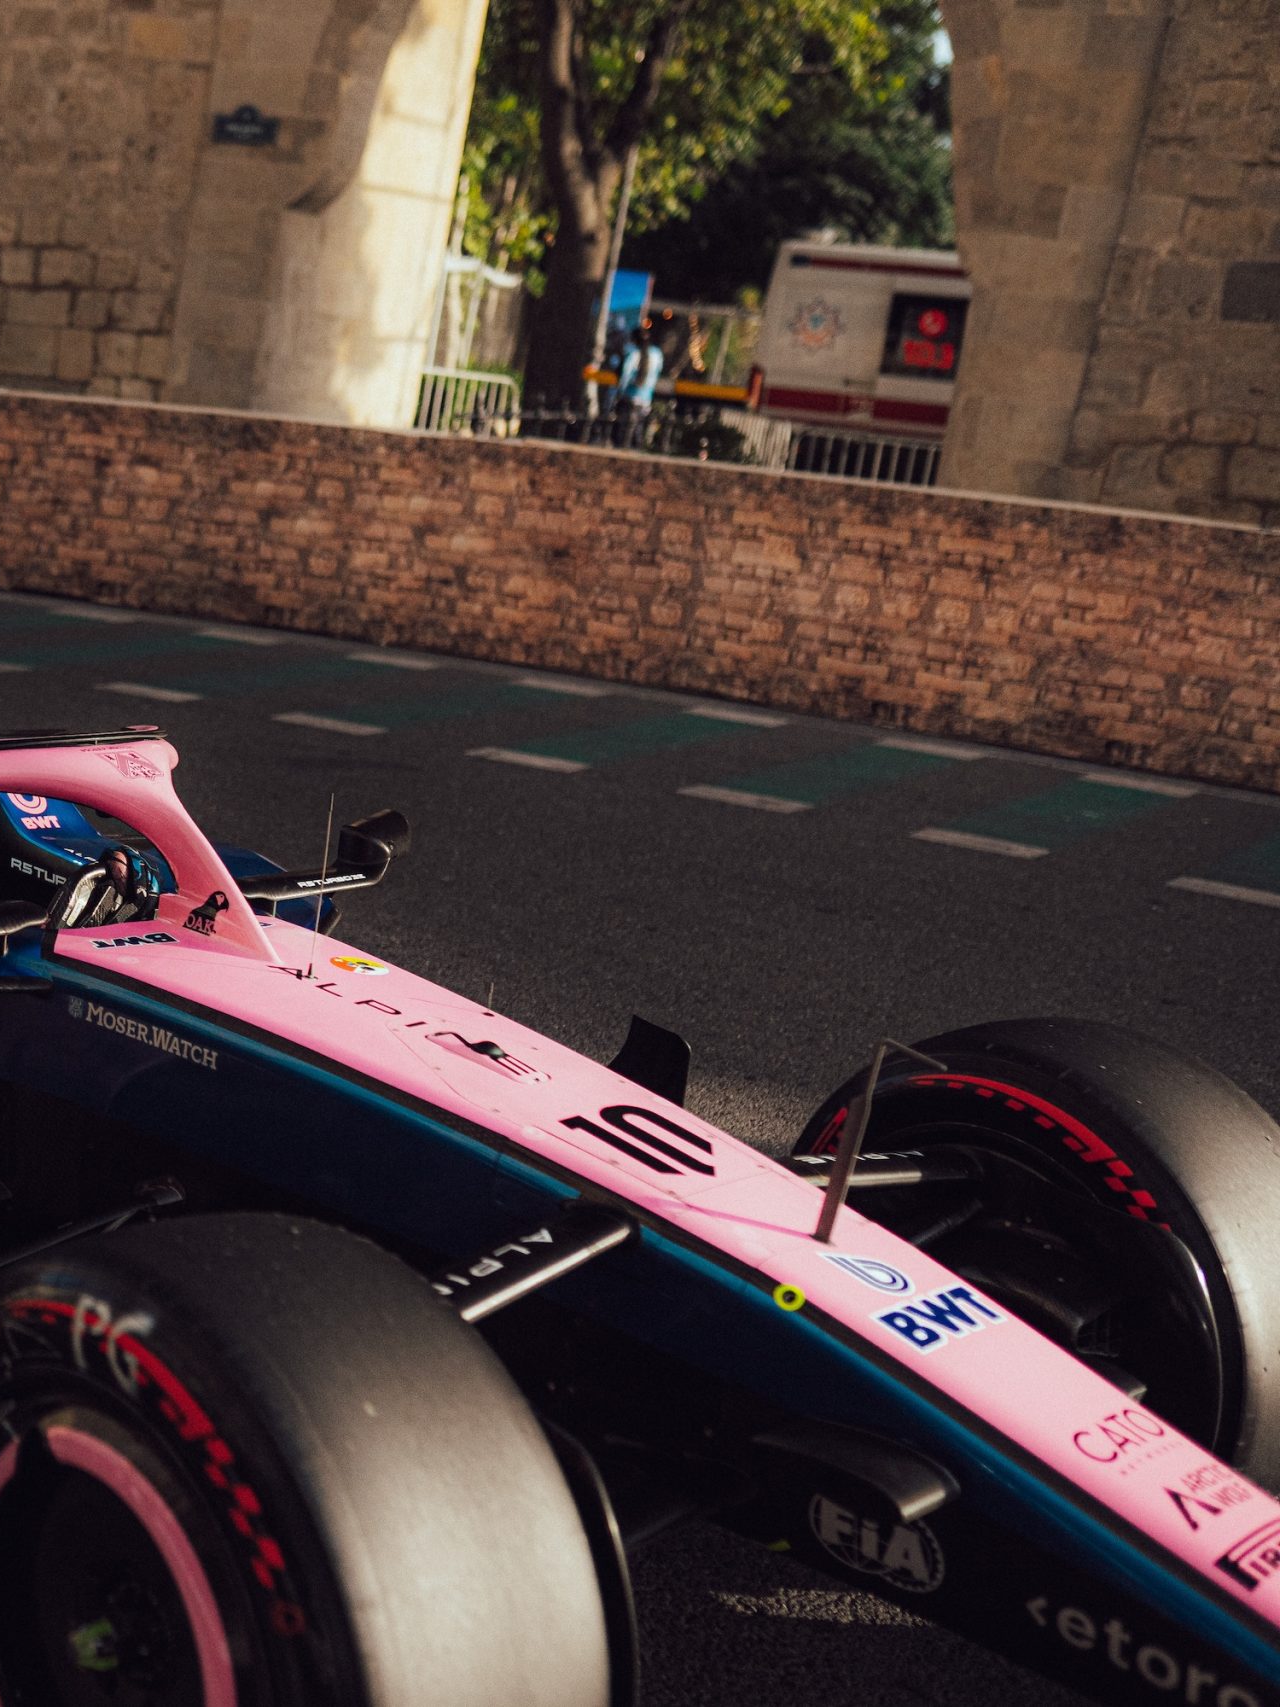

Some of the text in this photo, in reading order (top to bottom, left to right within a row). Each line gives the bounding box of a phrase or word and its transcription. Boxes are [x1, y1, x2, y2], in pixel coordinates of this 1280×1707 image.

[20, 815, 62, 830] BWT
[93, 932, 179, 949] BWT
[559, 1104, 717, 1177] 10
[875, 1286, 1001, 1349] BWT
[1073, 1408, 1165, 1464] CATO
